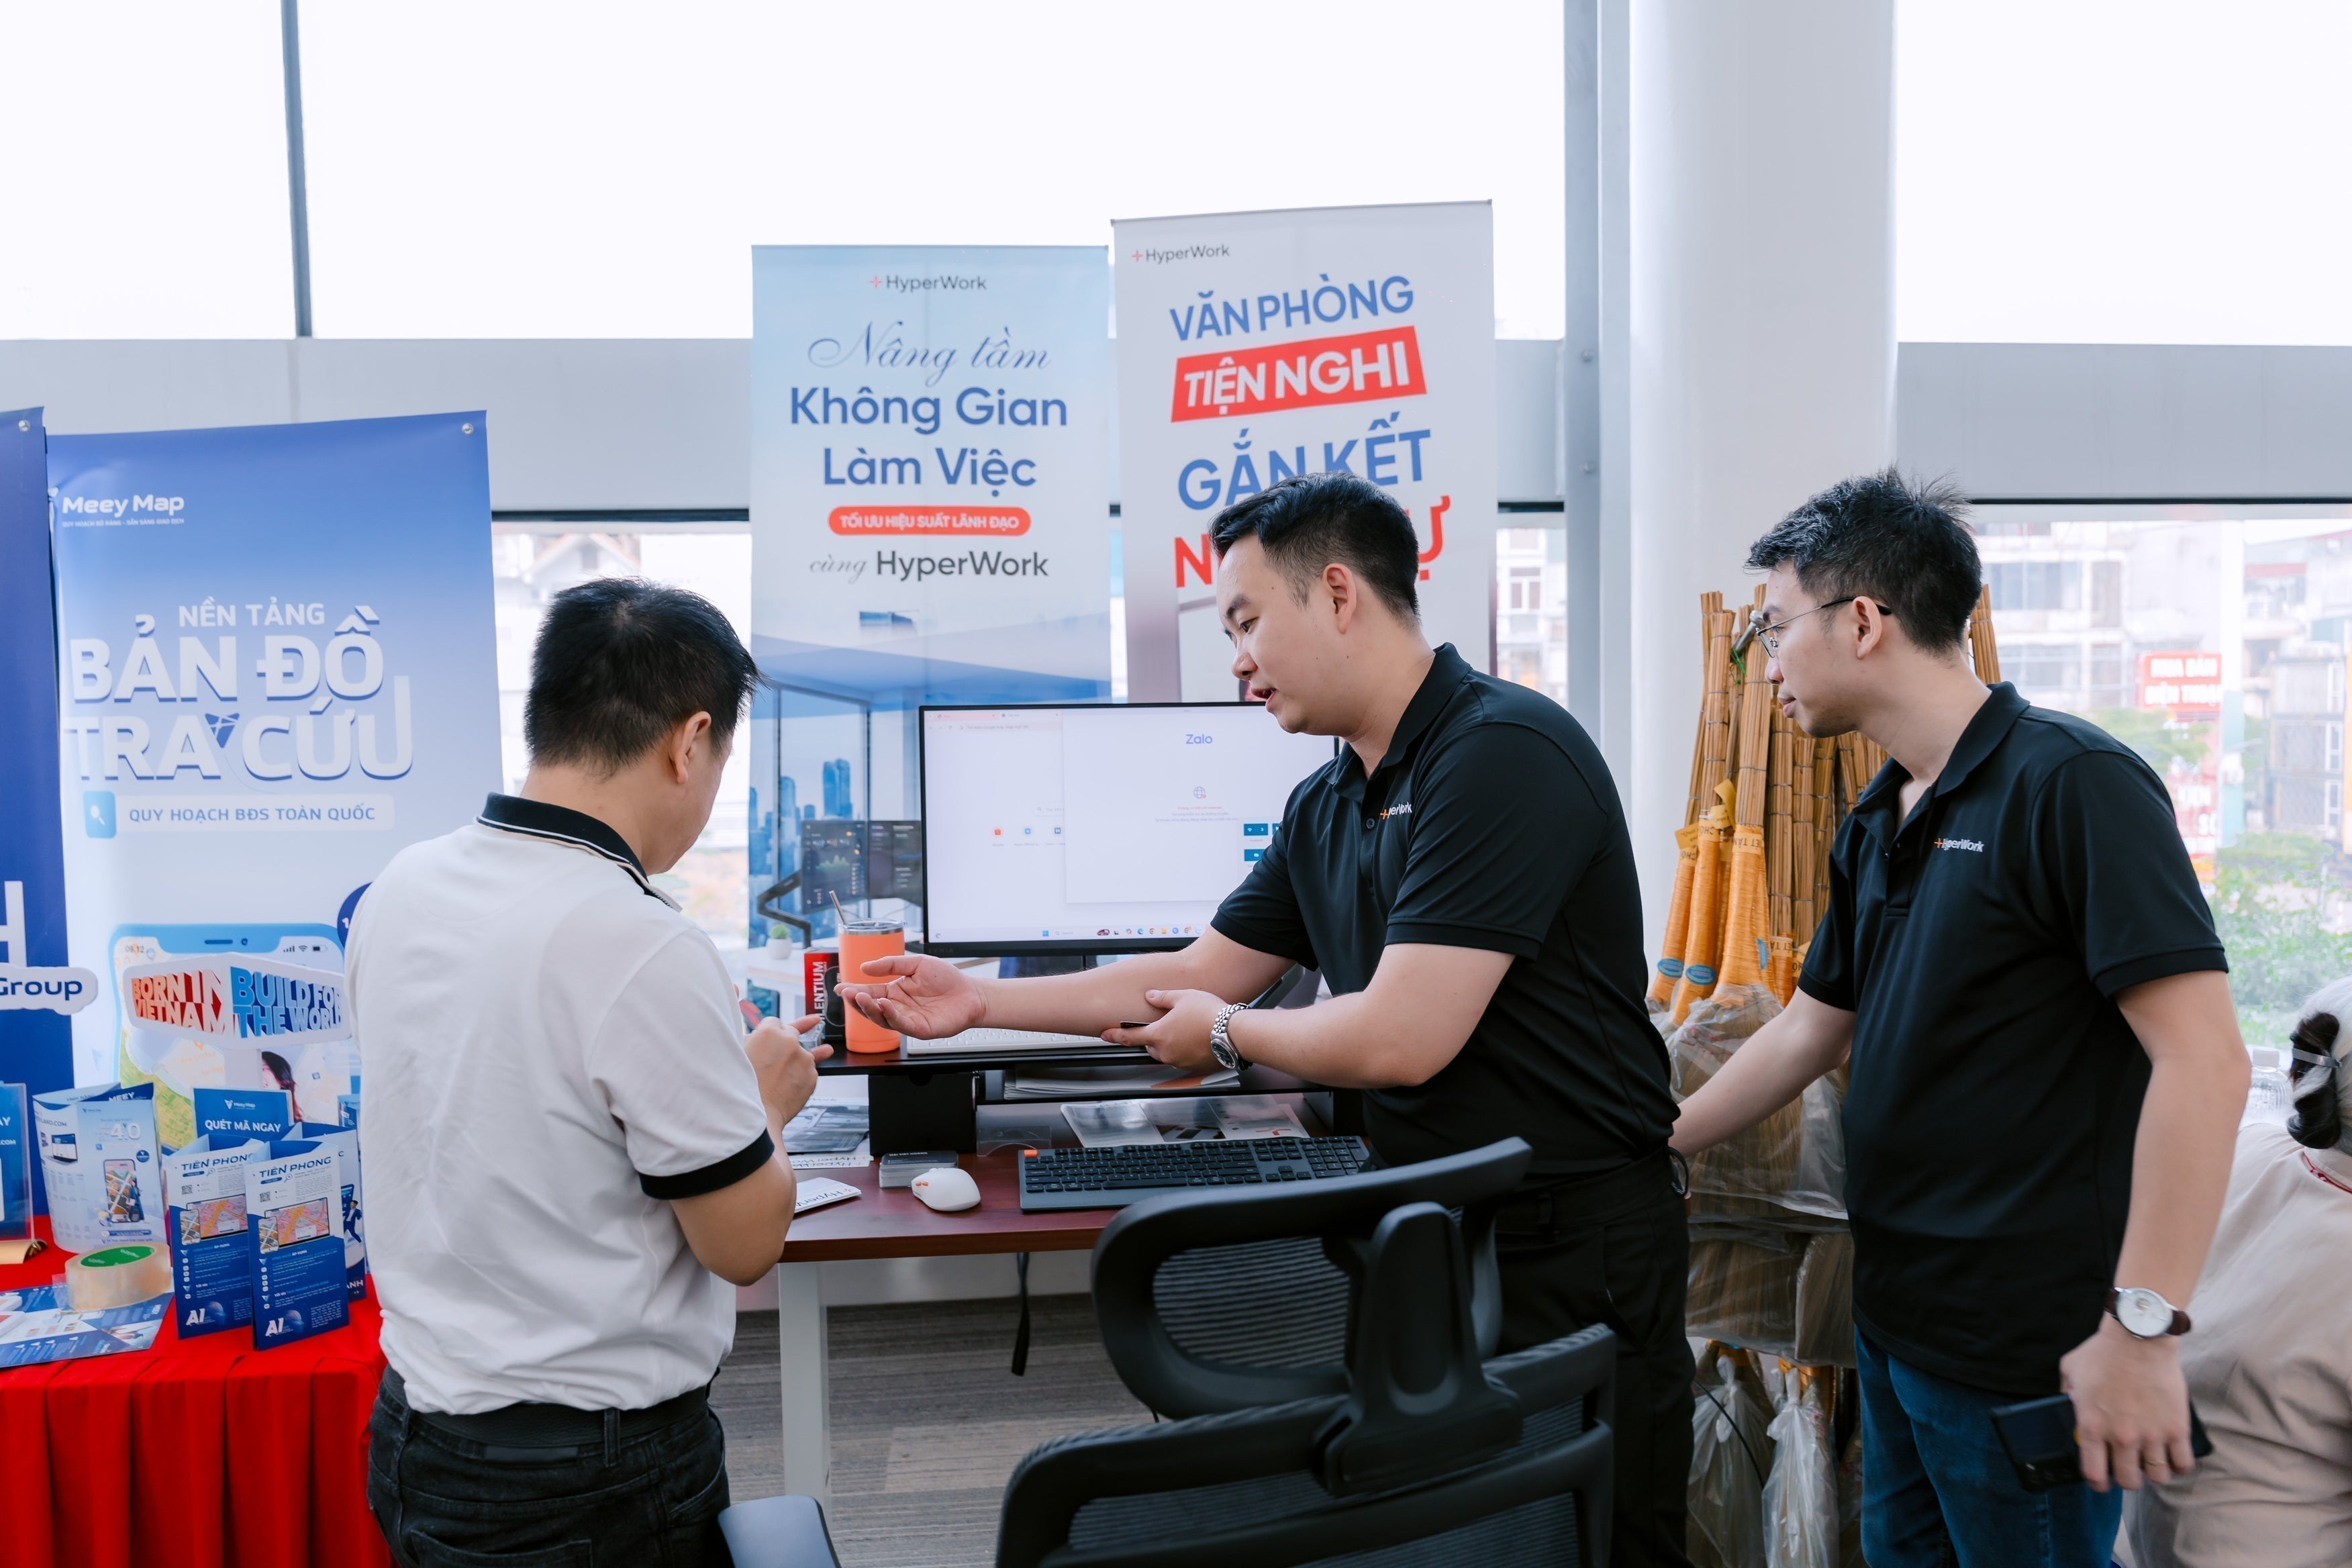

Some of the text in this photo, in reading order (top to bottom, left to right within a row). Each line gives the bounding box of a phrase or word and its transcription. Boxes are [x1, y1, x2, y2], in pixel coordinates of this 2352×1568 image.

[1146, 244, 1230, 264] HyperWork
[885, 275, 987, 293] HyperWork
[1169, 274, 1414, 340] VĂN PHÒNG
[808, 321, 1052, 387] Nâng tầm
[1184, 340, 1410, 415] TIỆN NGHI
[791, 387, 1068, 436] Không Gian
[1323, 411, 1431, 486] KẾT
[824, 448, 1037, 497] Làm Việc
[62, 494, 185, 518] Meey Map
[839, 511, 863, 528] TỐI
[885, 511, 916, 530] HIỆU
[916, 510, 951, 528] SUẤT
[952, 512, 987, 529] LÃNH
[988, 516, 1020, 532] ĐẠO
[810, 550, 1049, 583] cùng HyperWork
[179, 596, 326, 628] NỀN TẢNG
[69, 605, 385, 703] BẢN ĐỒ
[64, 676, 413, 781] TRA CỨU
[1185, 733, 1214, 745] Zalo
[130, 802, 376, 825] QUY HOẠCH BĐS TOÀN QUỐC
[131, 969, 223, 1005] BORN IN
[230, 966, 341, 1011] BUILD FOR
[134, 998, 236, 1036] VIETNAM
[233, 1004, 342, 1039] THE WORLD
[205, 1119, 282, 1133] QUÉT MÃ NGAY
[259, 1156, 332, 1178] TIÊN PHONG
[185, 1308, 206, 1327] AI
[264, 1317, 284, 1337] AI
